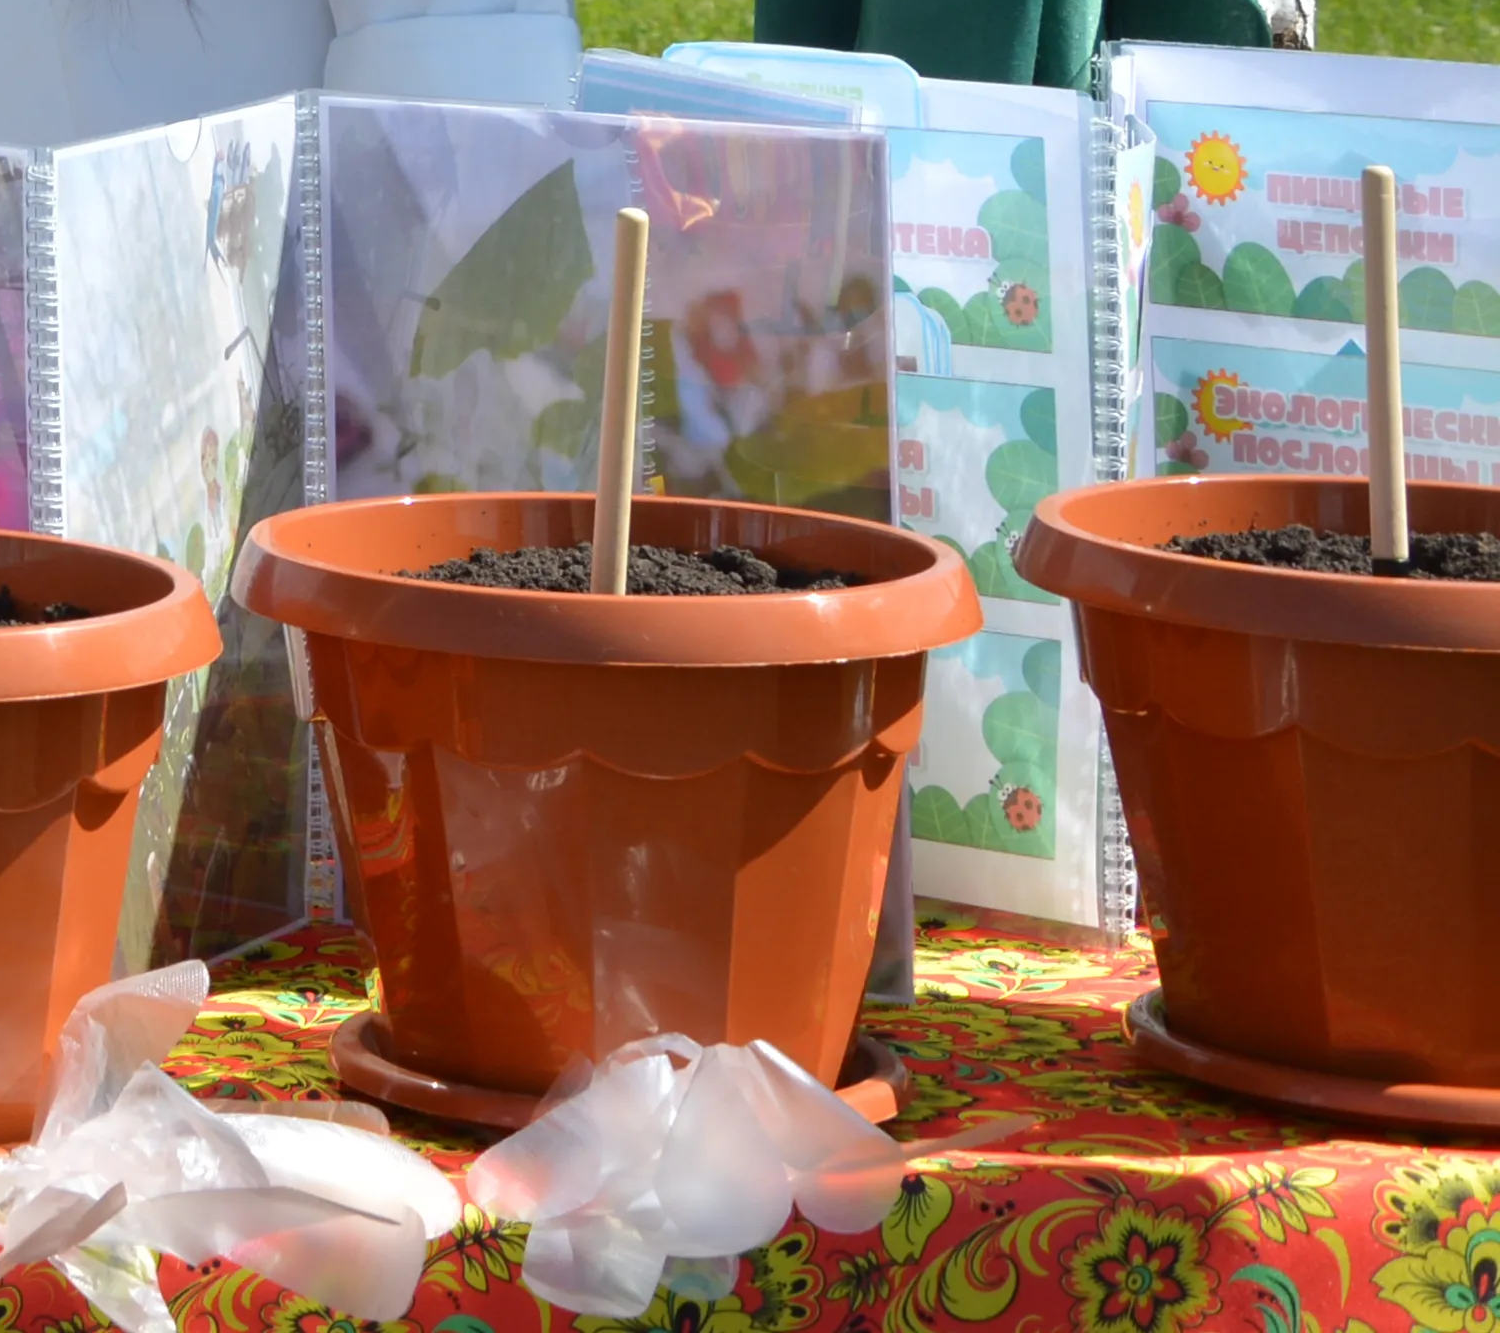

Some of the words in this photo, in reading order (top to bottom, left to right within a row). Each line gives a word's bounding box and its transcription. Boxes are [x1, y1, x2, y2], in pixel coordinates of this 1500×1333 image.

[1266, 174, 1464, 218] ПИЩЫЕ
[893, 222, 990, 259] ТЕКА
[1277, 219, 1454, 263] ЦЕПОКИ
